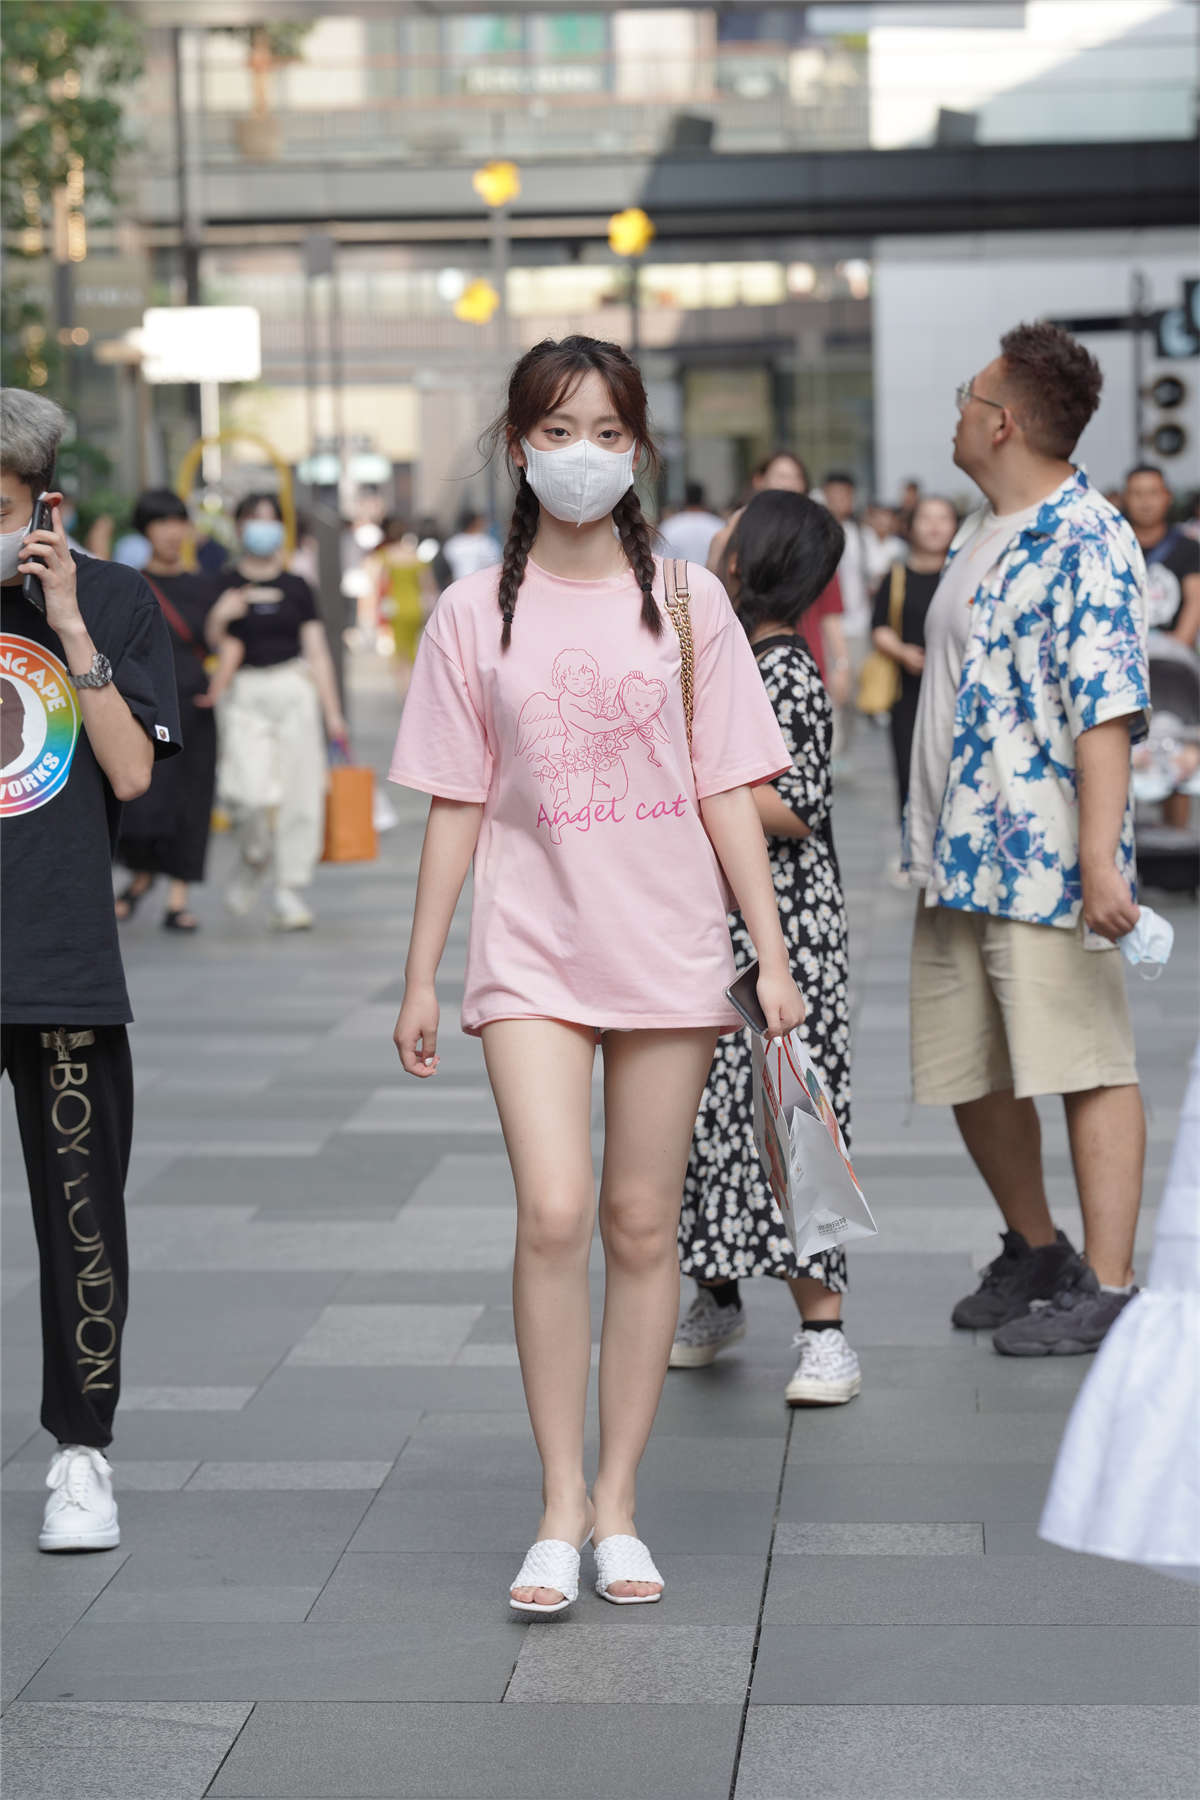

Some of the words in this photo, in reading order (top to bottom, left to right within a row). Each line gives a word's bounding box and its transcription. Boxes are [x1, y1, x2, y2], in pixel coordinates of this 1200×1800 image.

[27, 668, 67, 713] APE
[536, 796, 626, 832] Angel
[635, 793, 688, 821] cat
[50, 1062, 92, 1156] BOY
[64, 1171, 117, 1394] LONDON
